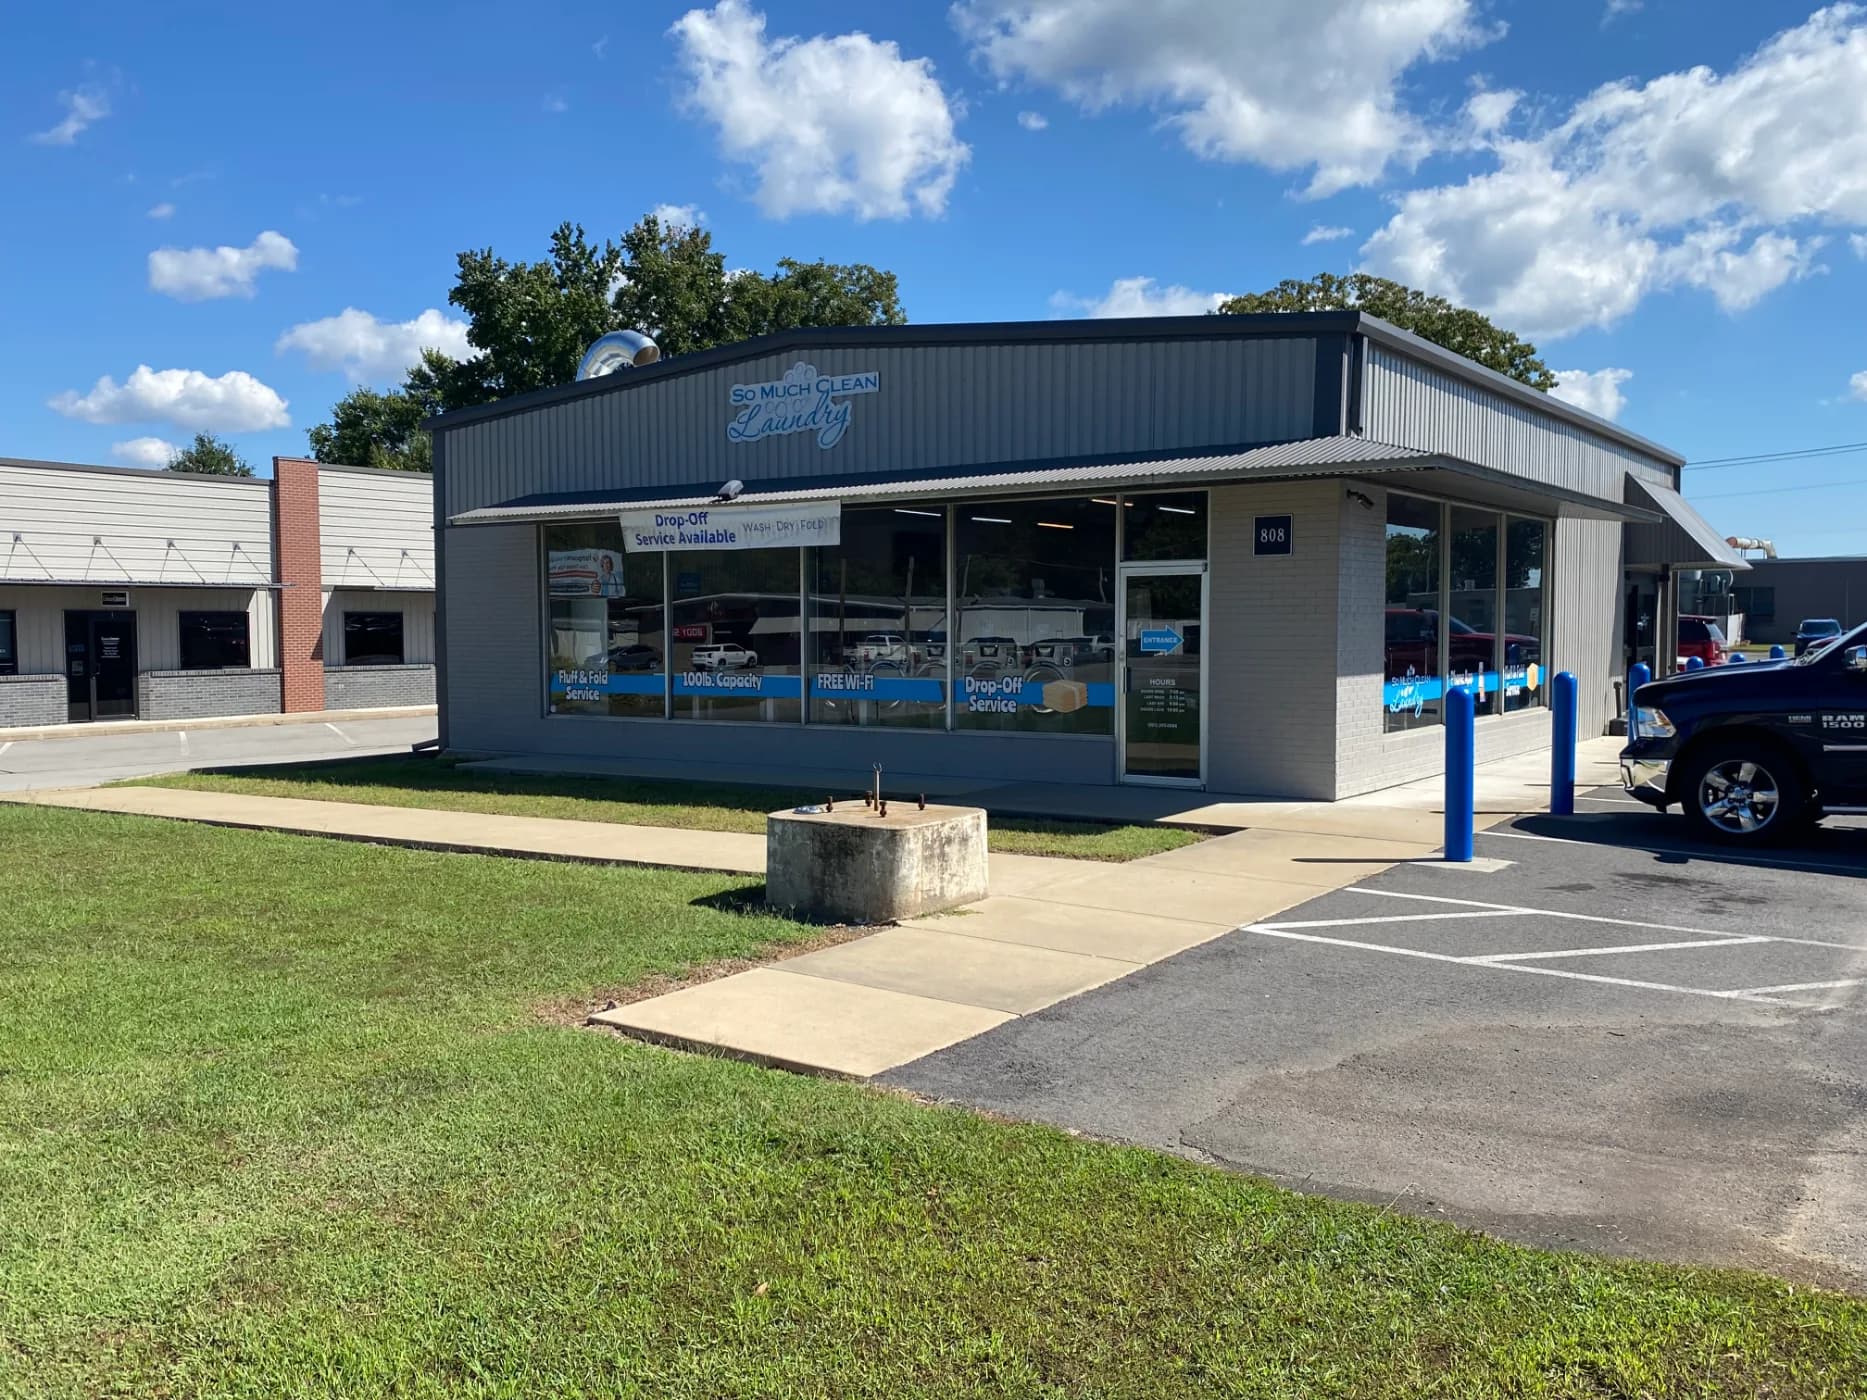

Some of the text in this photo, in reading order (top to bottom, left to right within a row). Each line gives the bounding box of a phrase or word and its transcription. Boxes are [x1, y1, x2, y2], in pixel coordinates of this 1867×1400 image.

[732, 375, 878, 403] SO MUCH CLEAN
[729, 392, 849, 446] Laundry
[655, 511, 708, 529] Drop-Off
[635, 528, 736, 546] Service Available
[1260, 528, 1285, 543] 808
[1143, 636, 1178, 645] ENTRANCE
[558, 670, 609, 685] Fluff & Fold
[716, 672, 763, 691] Capacity
[817, 673, 874, 691] FREE Wi-Fi
[965, 676, 1024, 697] Drop-Off
[565, 685, 600, 701] Service
[969, 696, 1017, 713] Service
